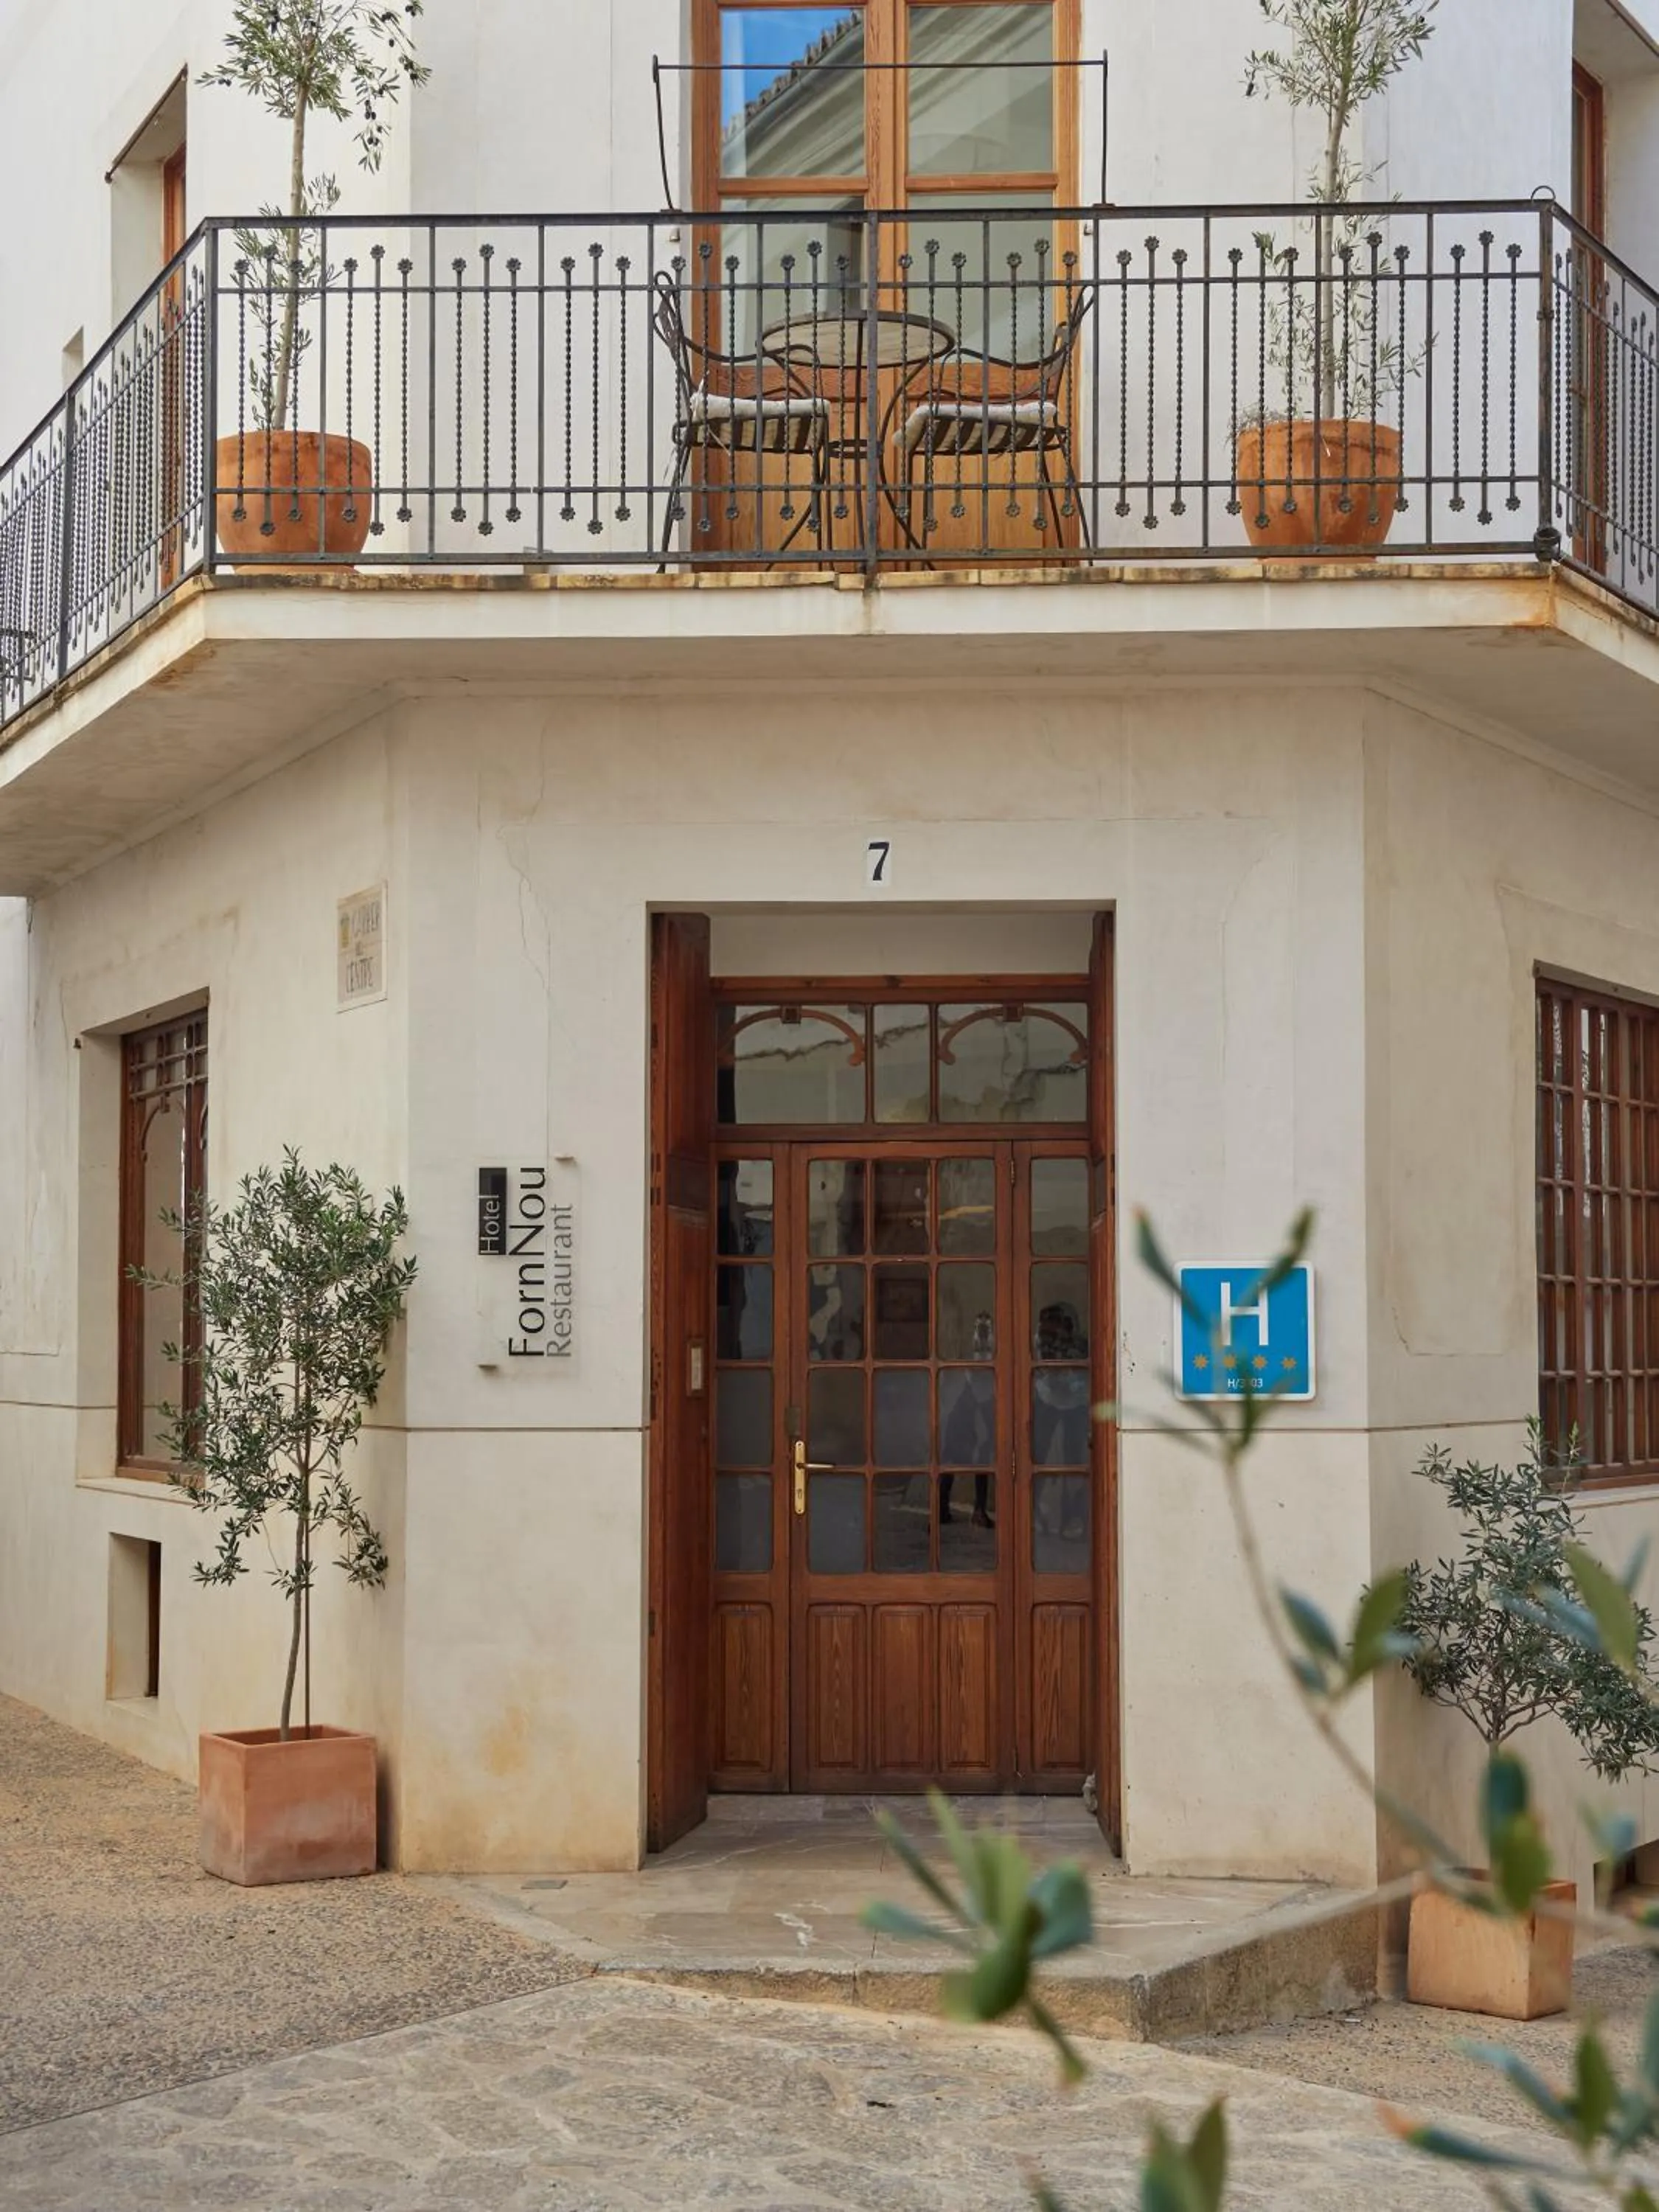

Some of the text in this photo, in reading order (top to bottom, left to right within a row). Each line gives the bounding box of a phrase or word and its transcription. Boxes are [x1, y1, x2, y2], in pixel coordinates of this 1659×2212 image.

[869, 841, 889, 880] 7
[478, 1194, 499, 1254] Hotel
[546, 1203, 573, 1357] Restaurant
[1220, 1281, 1269, 1346] H
